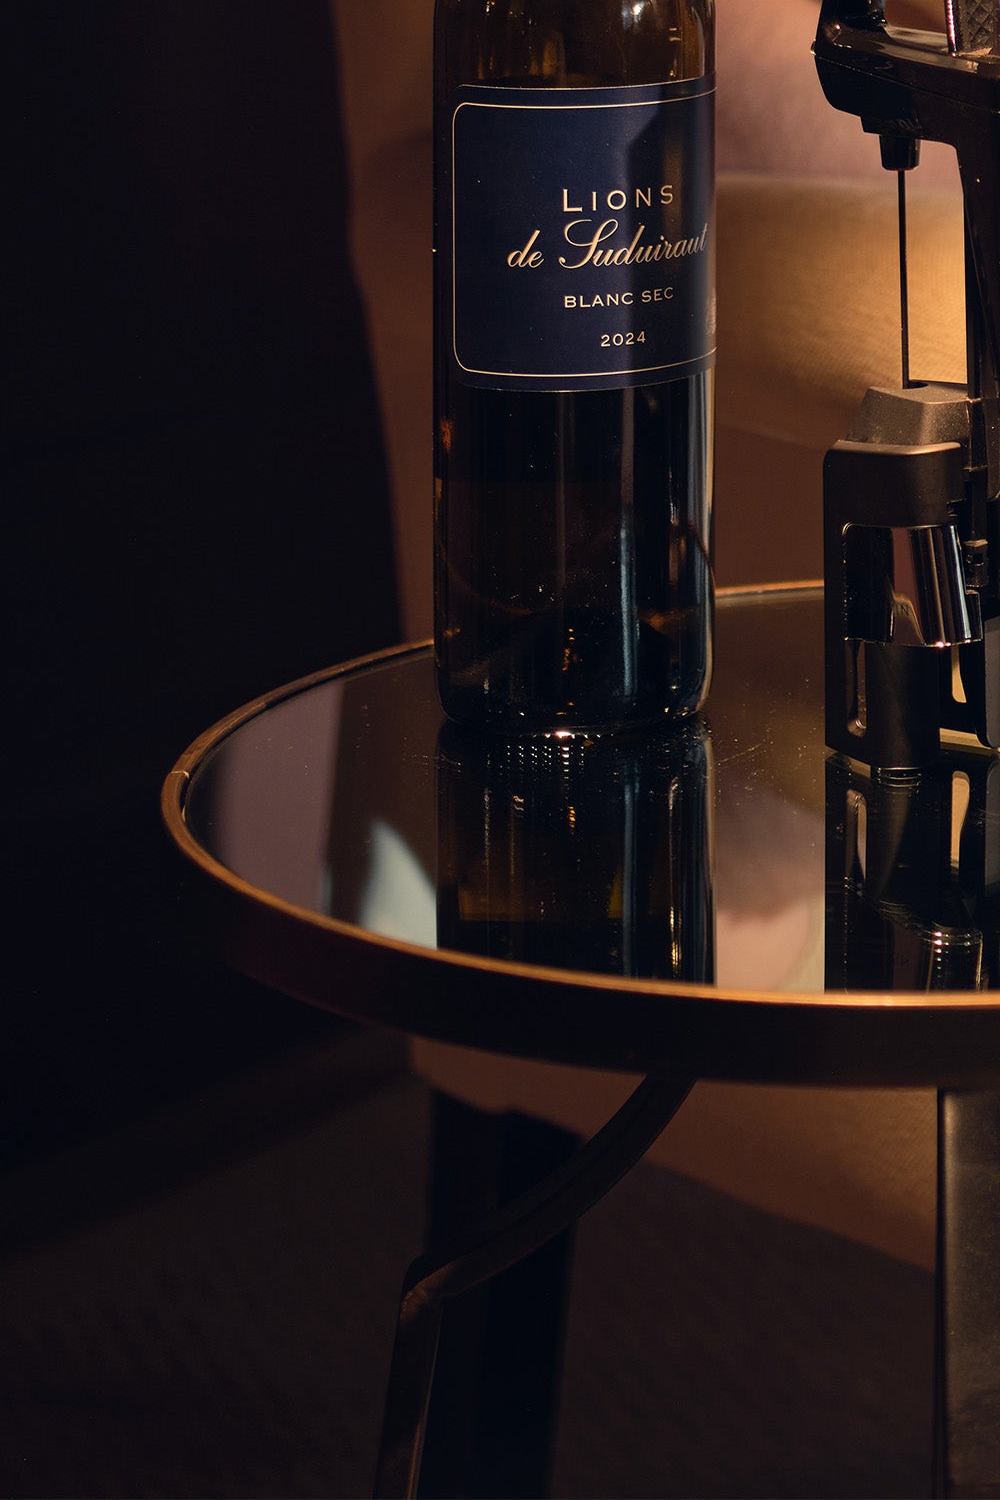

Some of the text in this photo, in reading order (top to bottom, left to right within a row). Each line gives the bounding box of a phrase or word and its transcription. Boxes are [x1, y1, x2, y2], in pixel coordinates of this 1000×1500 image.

[562, 184, 674, 213] LIONS
[506, 218, 708, 270] de Suduiraut
[563, 286, 674, 309] BLANC SEC
[600, 331, 646, 348] 2024
